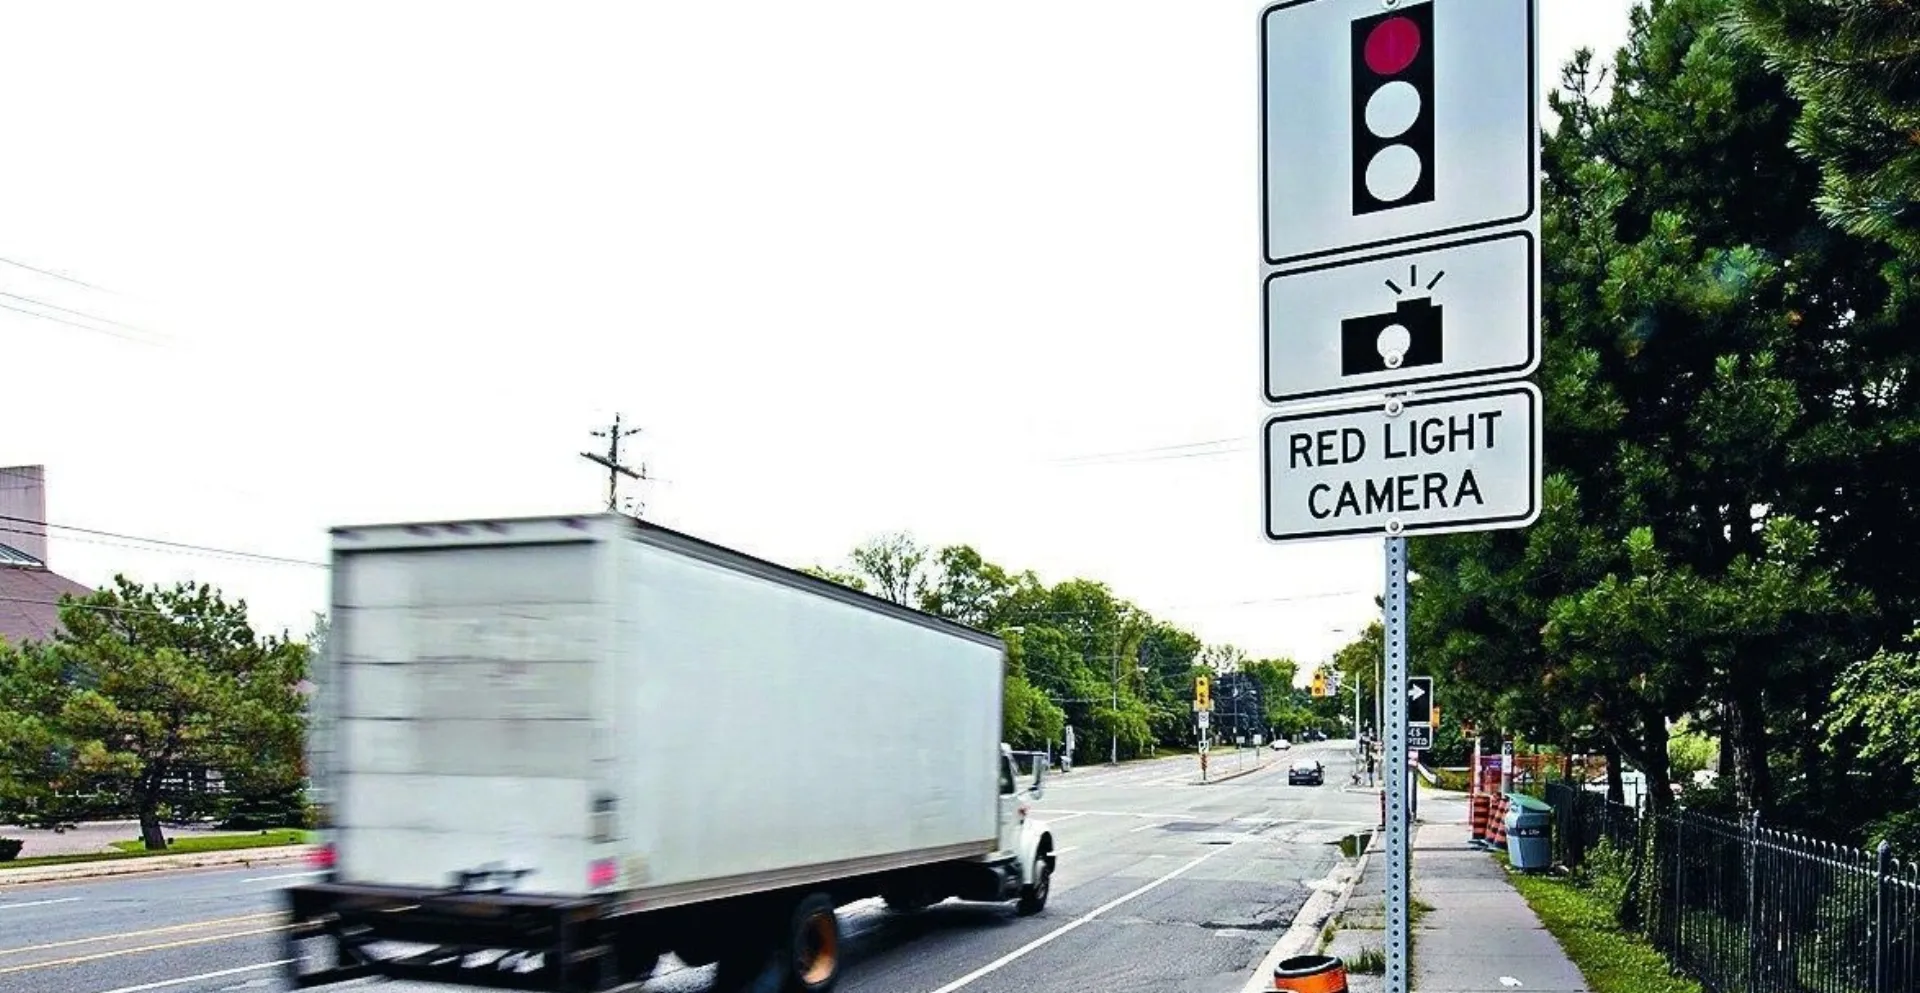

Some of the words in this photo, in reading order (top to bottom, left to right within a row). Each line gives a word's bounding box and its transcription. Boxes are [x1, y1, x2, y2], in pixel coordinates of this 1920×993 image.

[1290, 428, 1366, 468] RED
[1384, 410, 1502, 460] LIGHT
[1308, 469, 1484, 519] CAMERA
